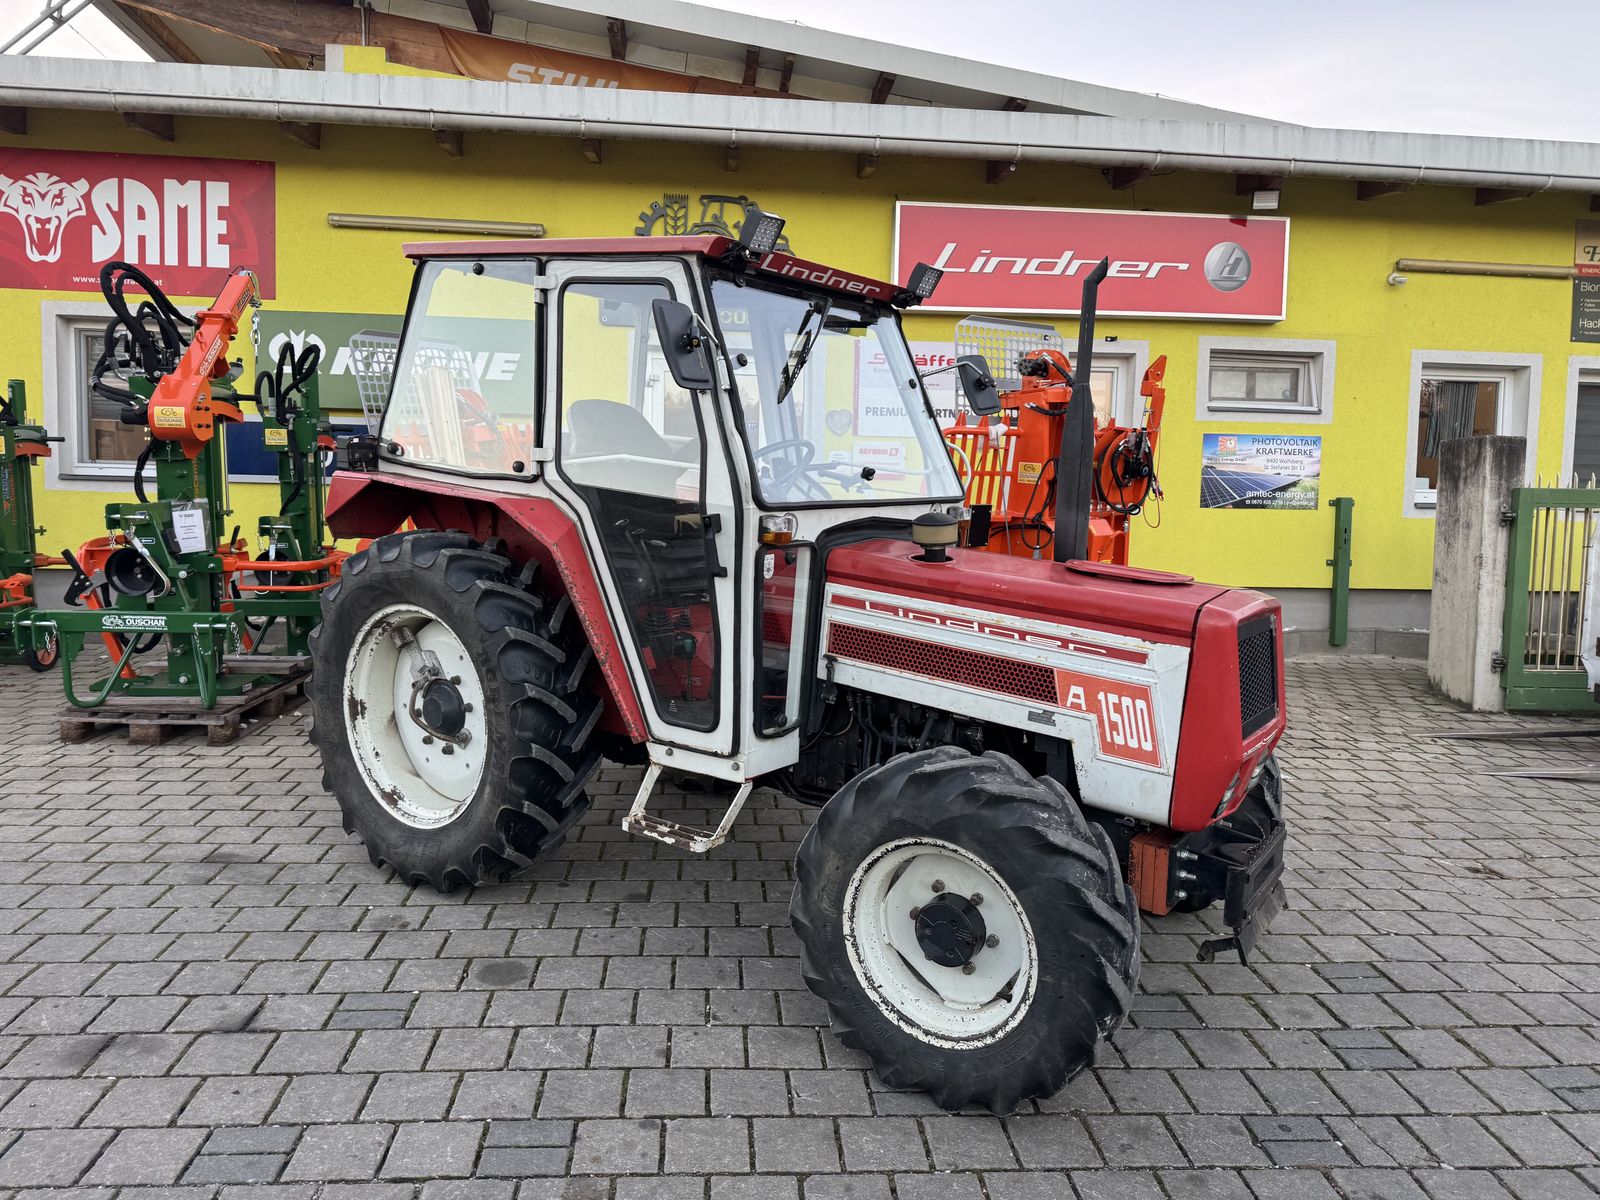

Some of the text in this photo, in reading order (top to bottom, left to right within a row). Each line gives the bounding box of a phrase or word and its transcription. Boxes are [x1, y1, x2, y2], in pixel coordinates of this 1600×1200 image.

[506, 62, 620, 90] STI
[90, 177, 230, 269] SAME
[760, 253, 881, 295] Lindner
[933, 242, 1190, 279] Lindner
[865, 406, 907, 417] PREMIU
[1251, 437, 1319, 447] PHOTOVOLTAIK
[1256, 447, 1314, 456] KRAFTWERKE
[1245, 490, 1315, 500] amtec-energy.at
[125, 618, 165, 627] OUSCHAN
[865, 600, 1107, 654] Lindner
[1066, 685, 1153, 751] A 1500
